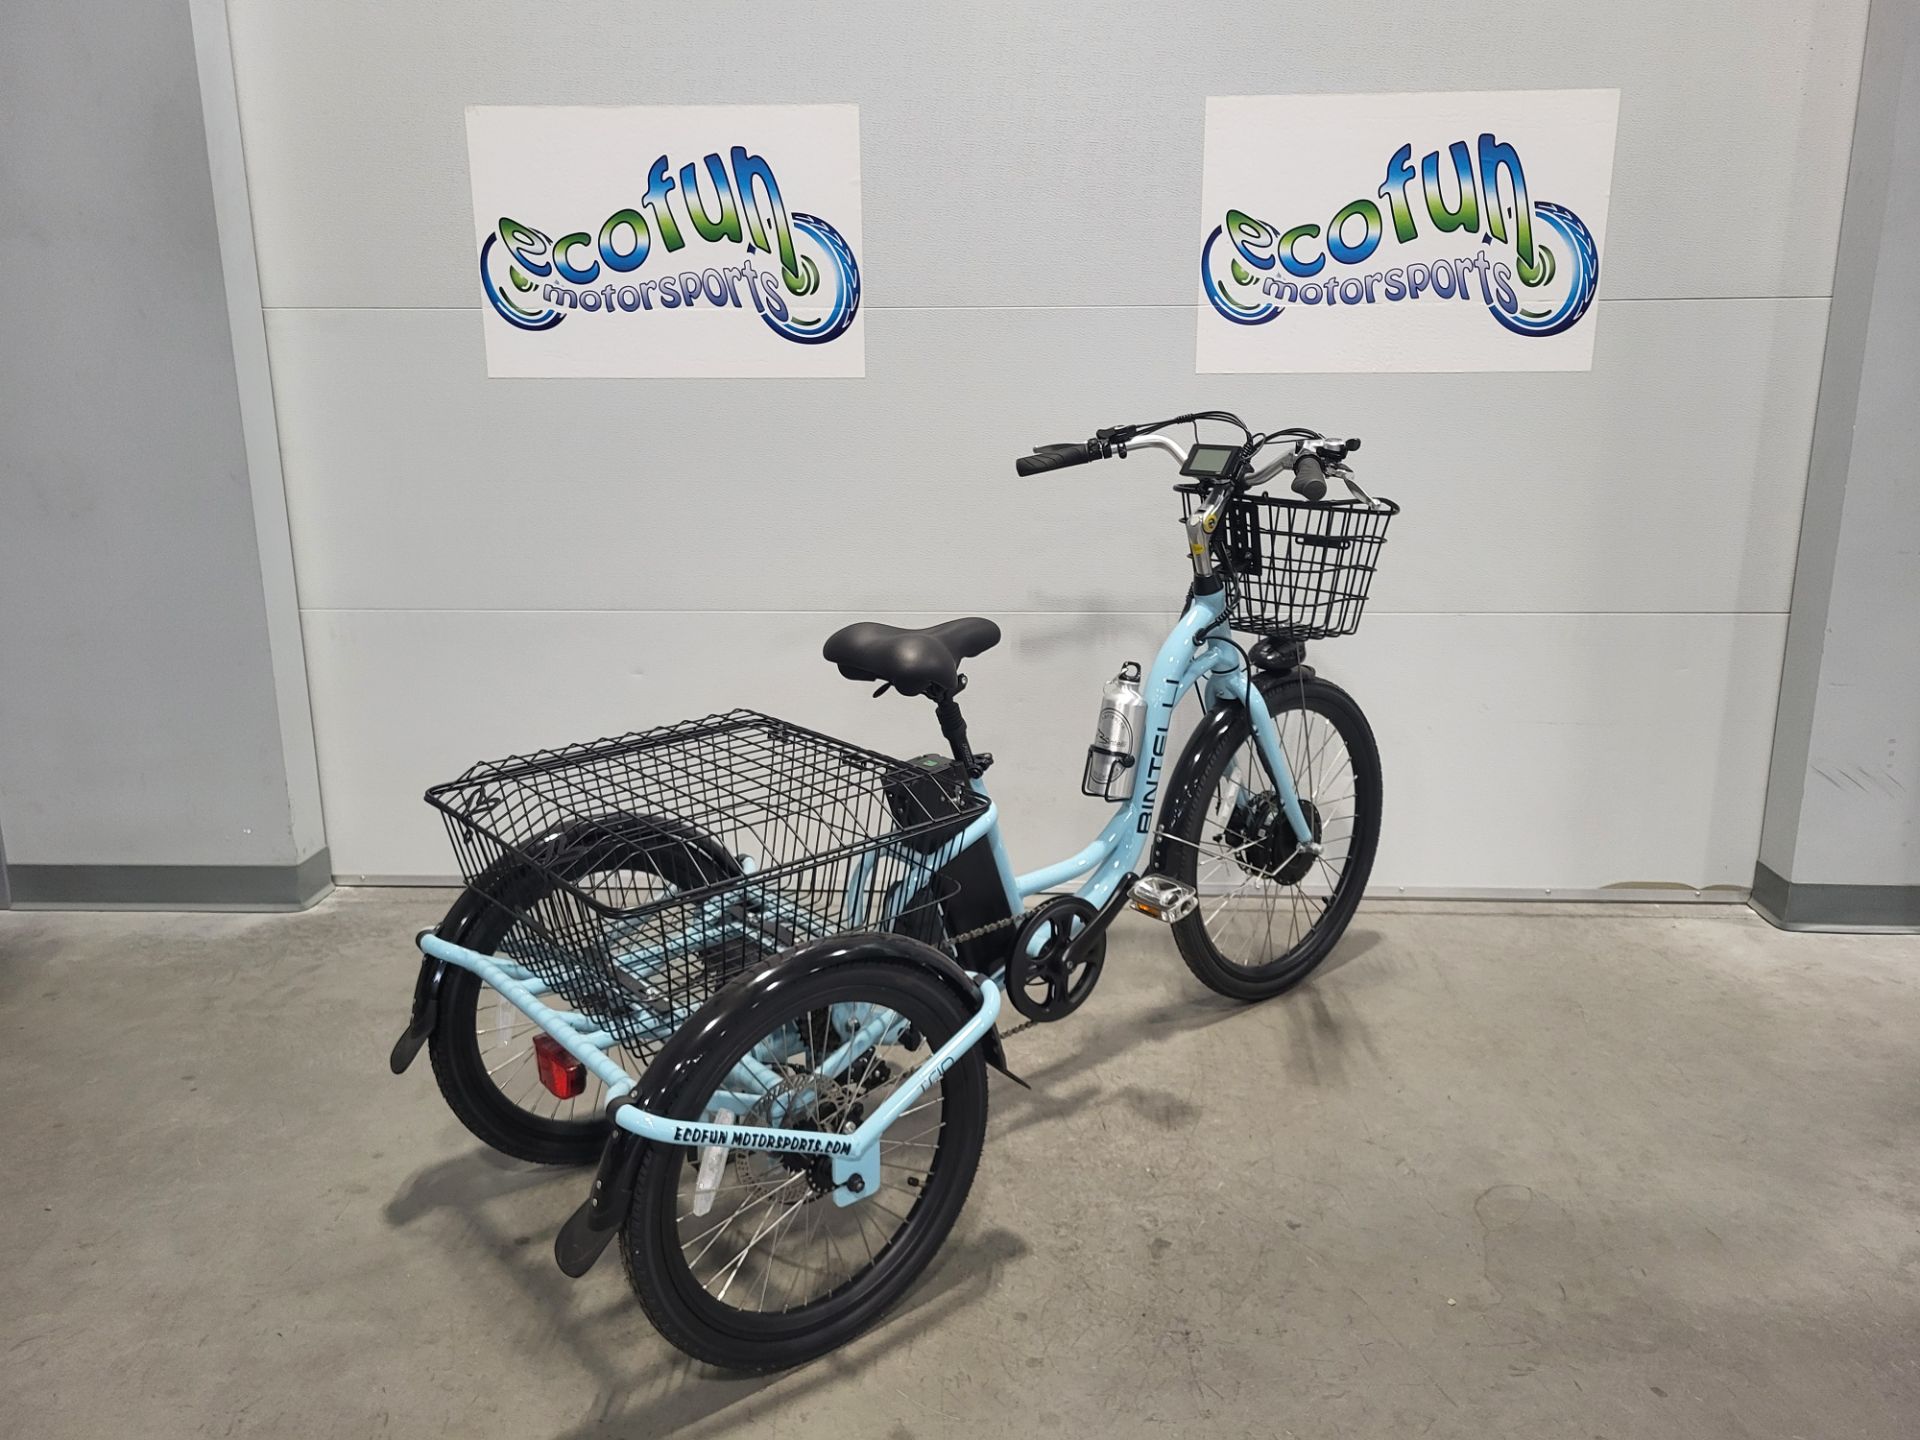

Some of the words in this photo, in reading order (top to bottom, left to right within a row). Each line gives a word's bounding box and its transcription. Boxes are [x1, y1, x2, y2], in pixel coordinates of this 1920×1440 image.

[498, 146, 800, 278] ecofun
[1226, 133, 1535, 270] ecofun
[543, 259, 790, 323] motorsports
[1262, 250, 1519, 315] motorsports
[674, 1126, 728, 1145] ECOFUN
[731, 1131, 852, 1156] MOTORSPORTS.COM
